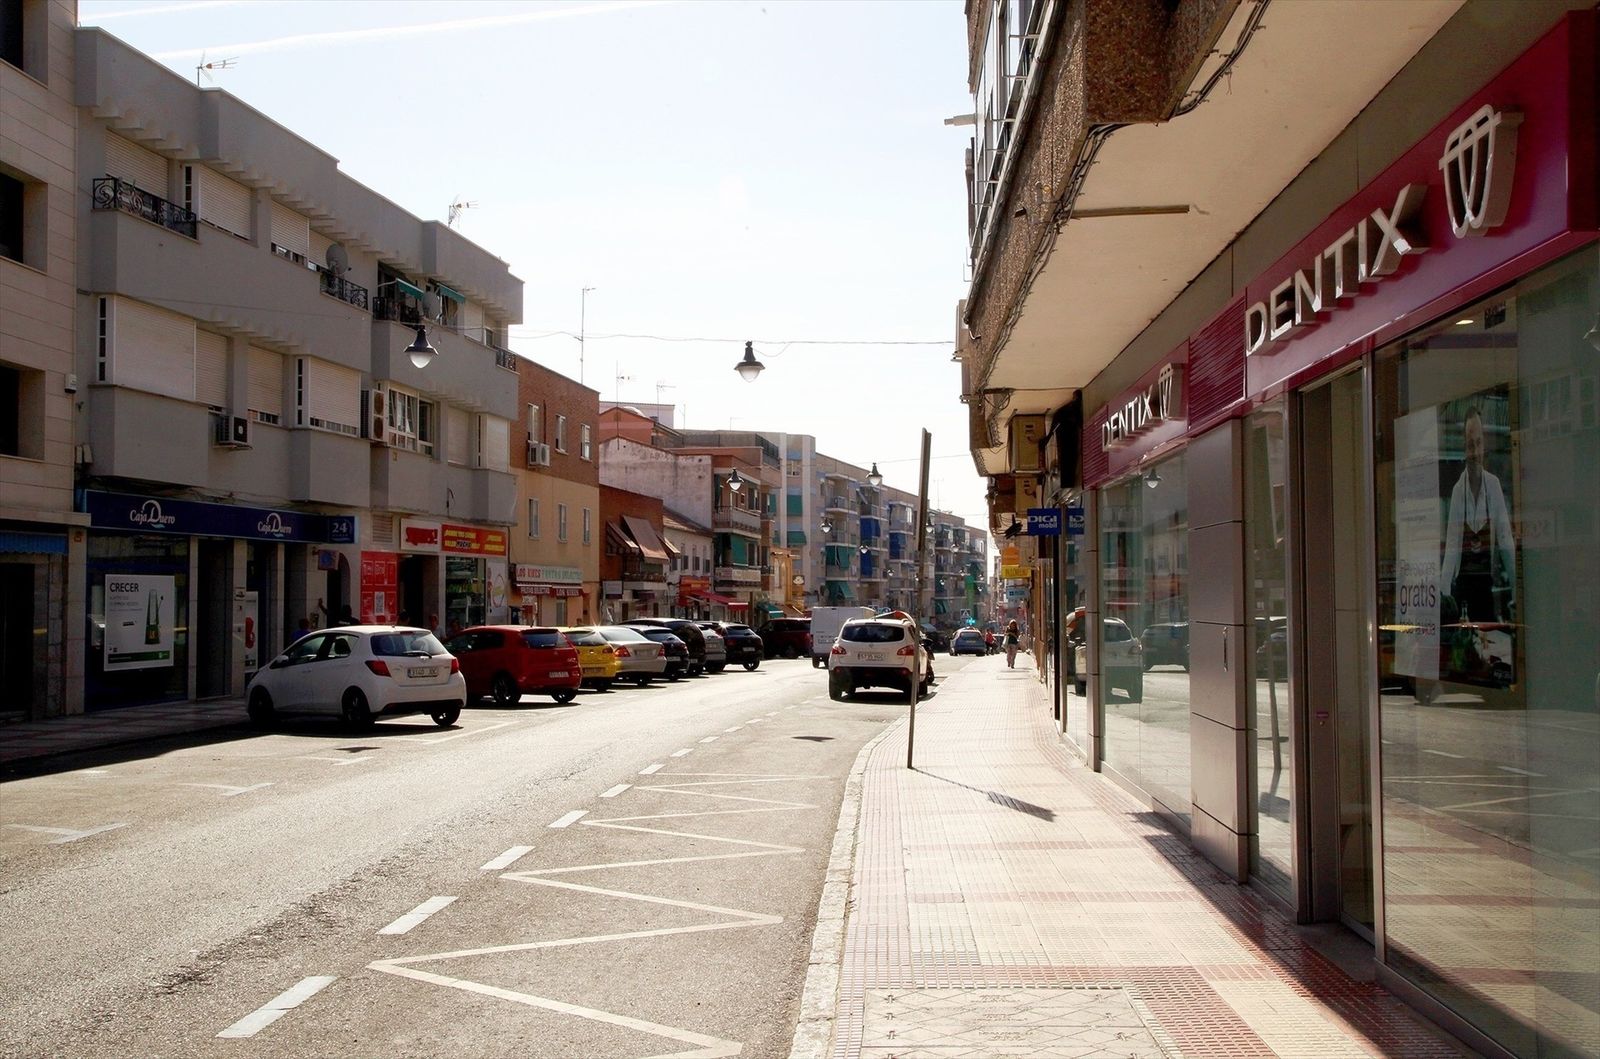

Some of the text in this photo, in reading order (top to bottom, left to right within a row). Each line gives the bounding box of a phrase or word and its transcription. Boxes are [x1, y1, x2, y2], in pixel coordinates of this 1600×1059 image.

[1246, 183, 1412, 356] DENTIX
[1102, 384, 1154, 452] DENTIX
[129, 500, 176, 525] Caja Duero
[258, 512, 292, 535] Caja Duero
[332, 523, 348, 534] 24
[109, 582, 139, 593] CRECER
[1400, 579, 1436, 614] gratis
